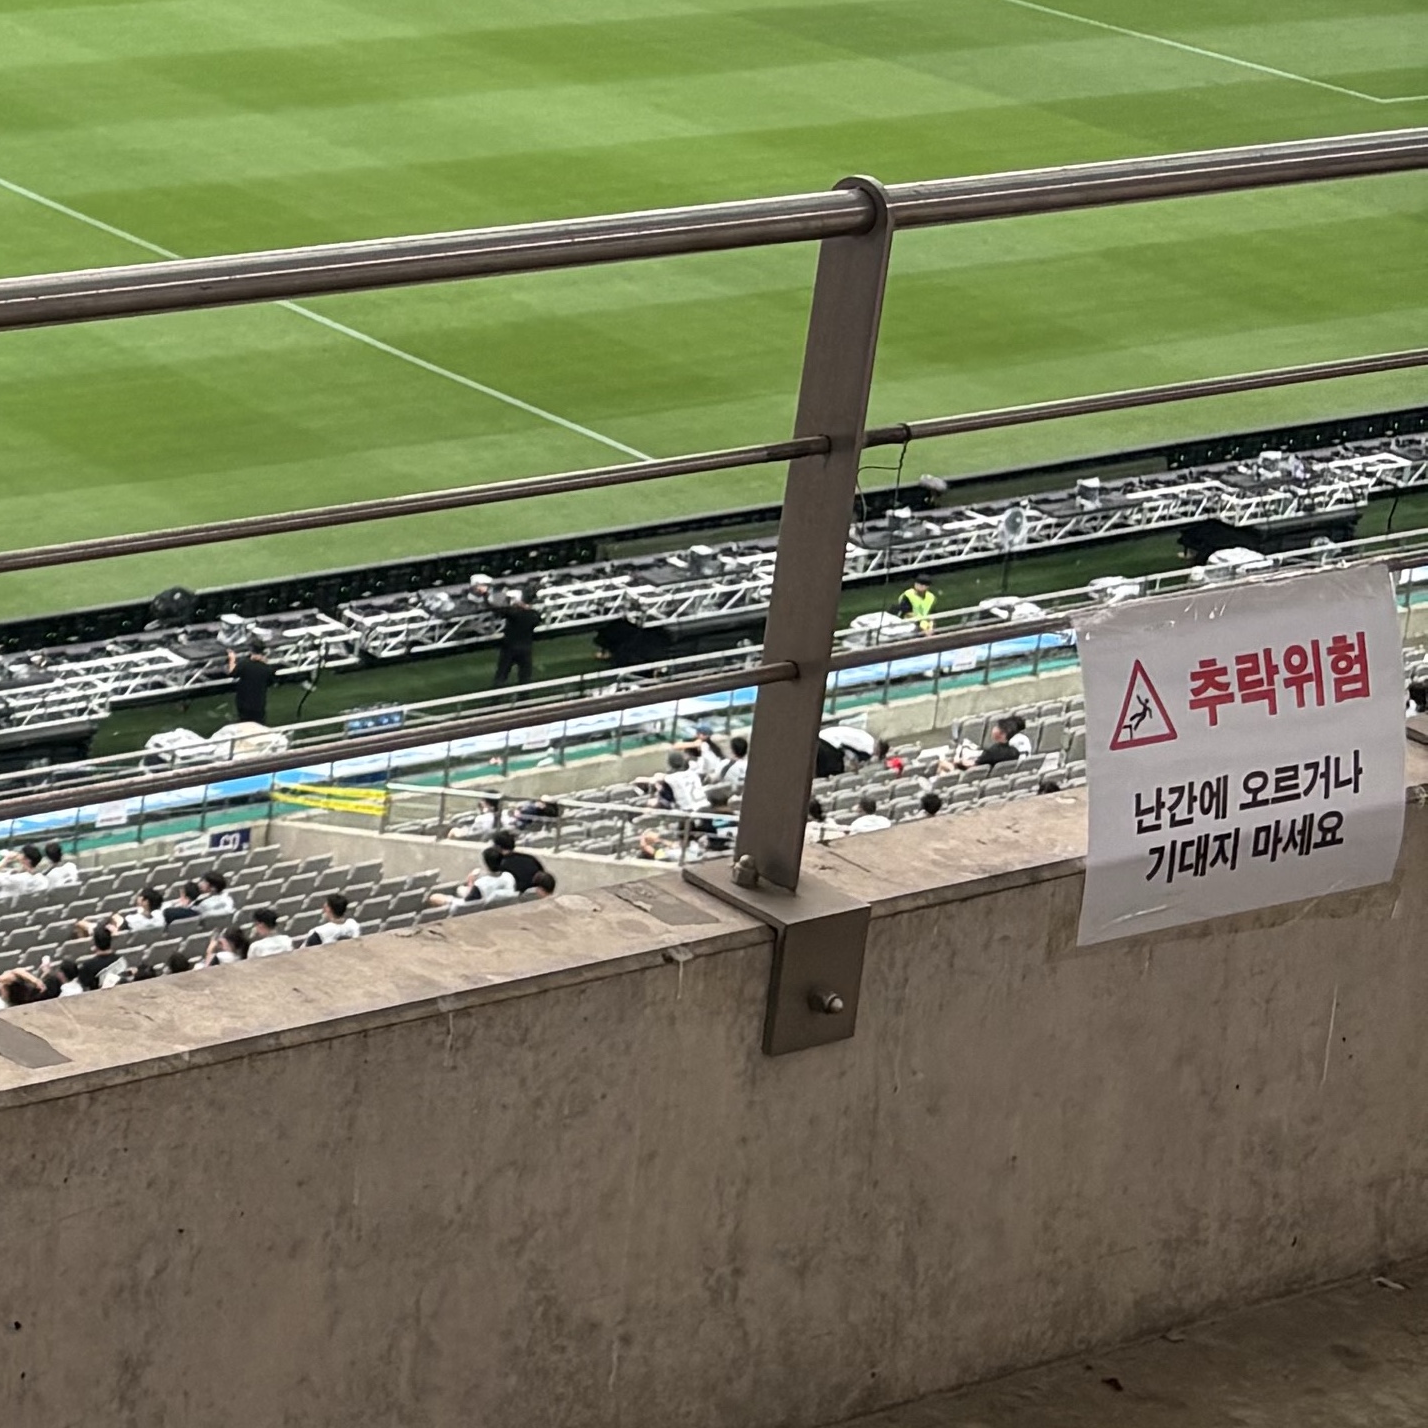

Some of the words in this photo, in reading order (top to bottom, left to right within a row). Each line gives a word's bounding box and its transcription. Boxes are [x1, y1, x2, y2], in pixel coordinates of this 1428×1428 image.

[1188, 631, 1371, 727] 추락위험
[1134, 774, 1228, 835] 난간에
[1238, 749, 1363, 811] 오르거나
[1145, 827, 1241, 884] 기대지
[1251, 810, 1345, 863] 마세요
